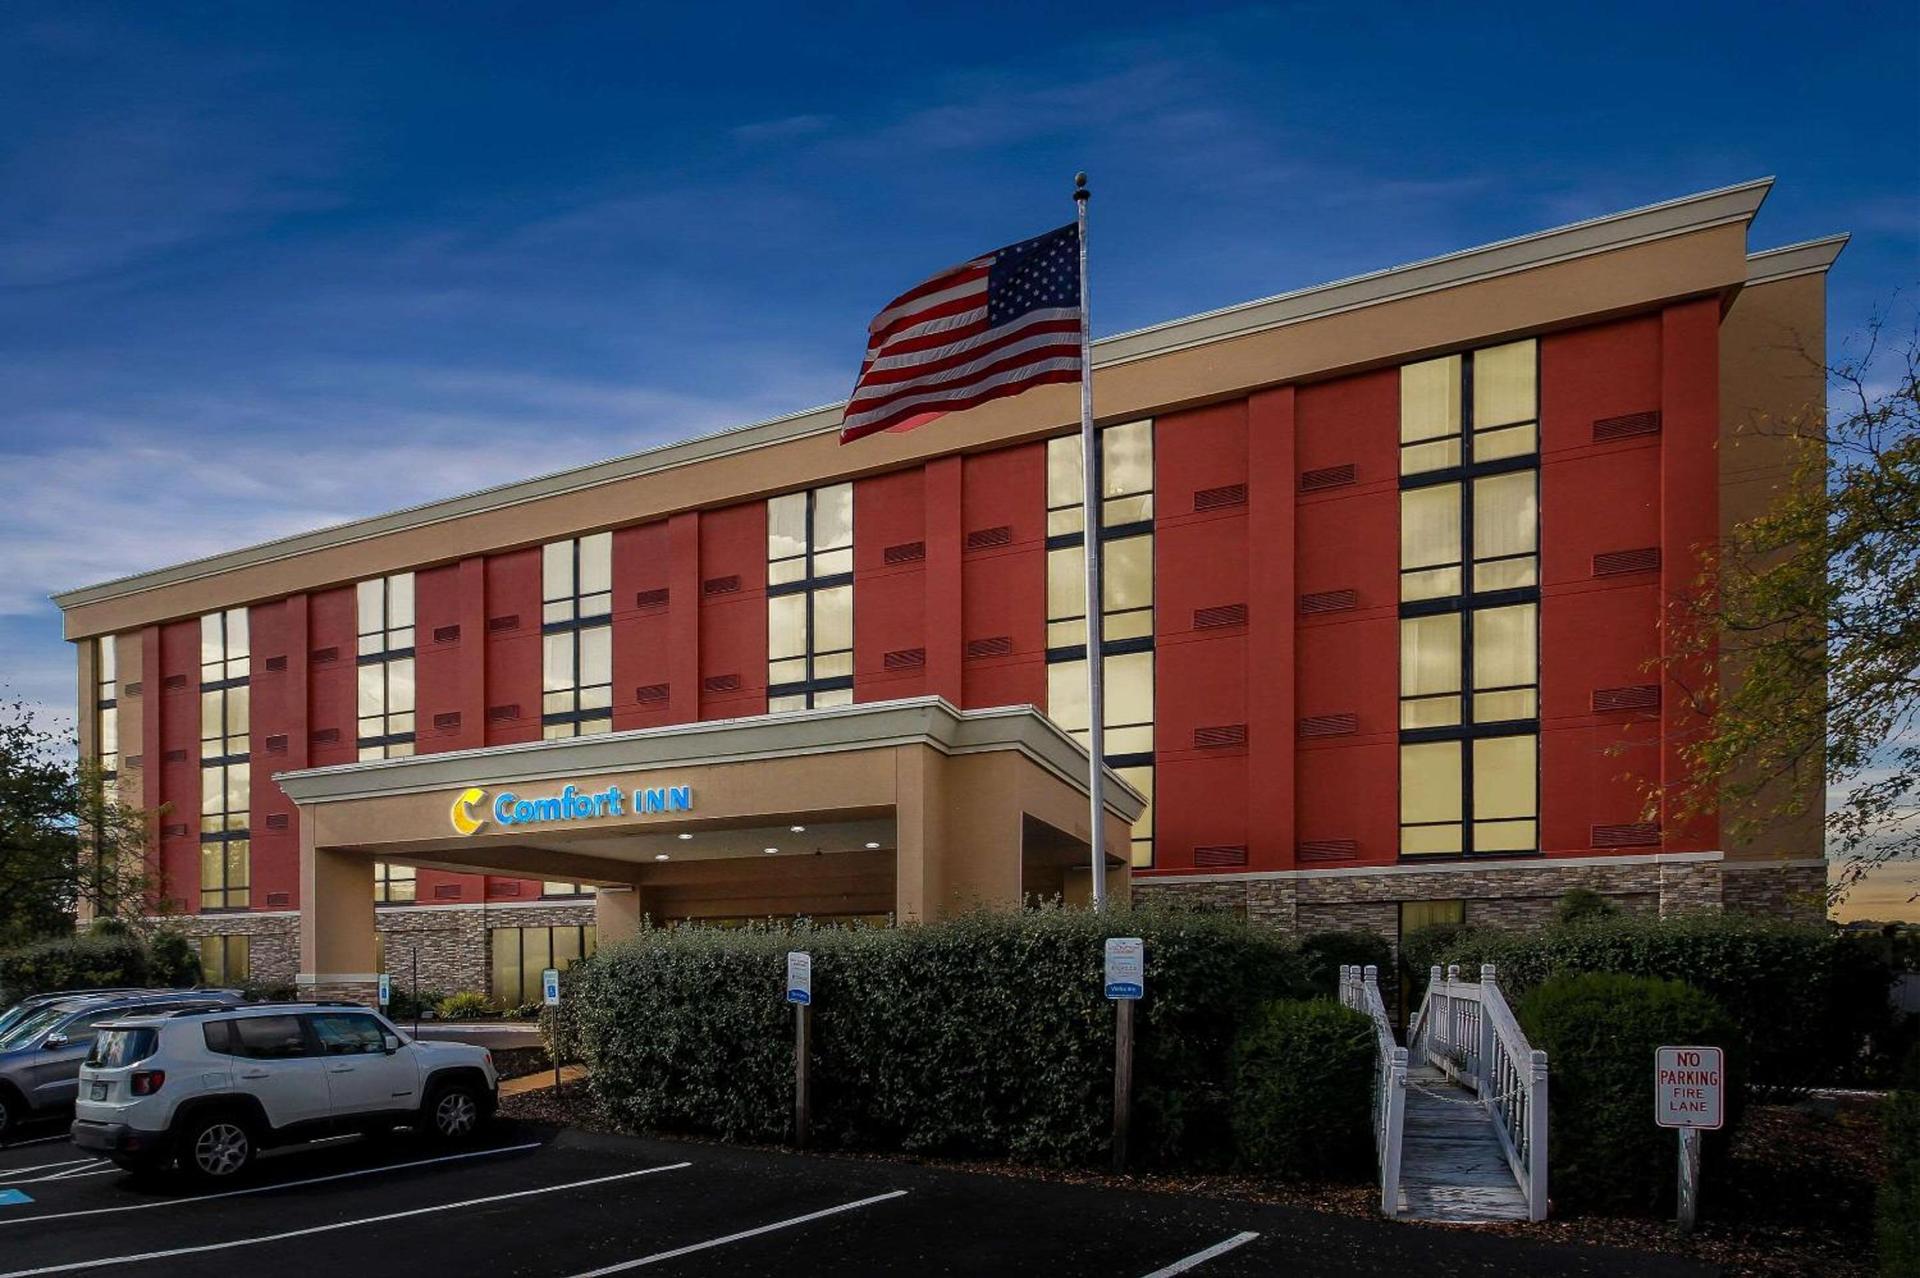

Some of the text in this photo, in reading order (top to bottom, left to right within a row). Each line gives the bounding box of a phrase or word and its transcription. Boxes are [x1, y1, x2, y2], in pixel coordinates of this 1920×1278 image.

[494, 784, 693, 825] Comfort INN
[1677, 1052, 1700, 1067] NO
[1660, 1070, 1718, 1086] PARKING
[1673, 1087, 1705, 1099] FIRE
[1669, 1101, 1708, 1112] LANE
